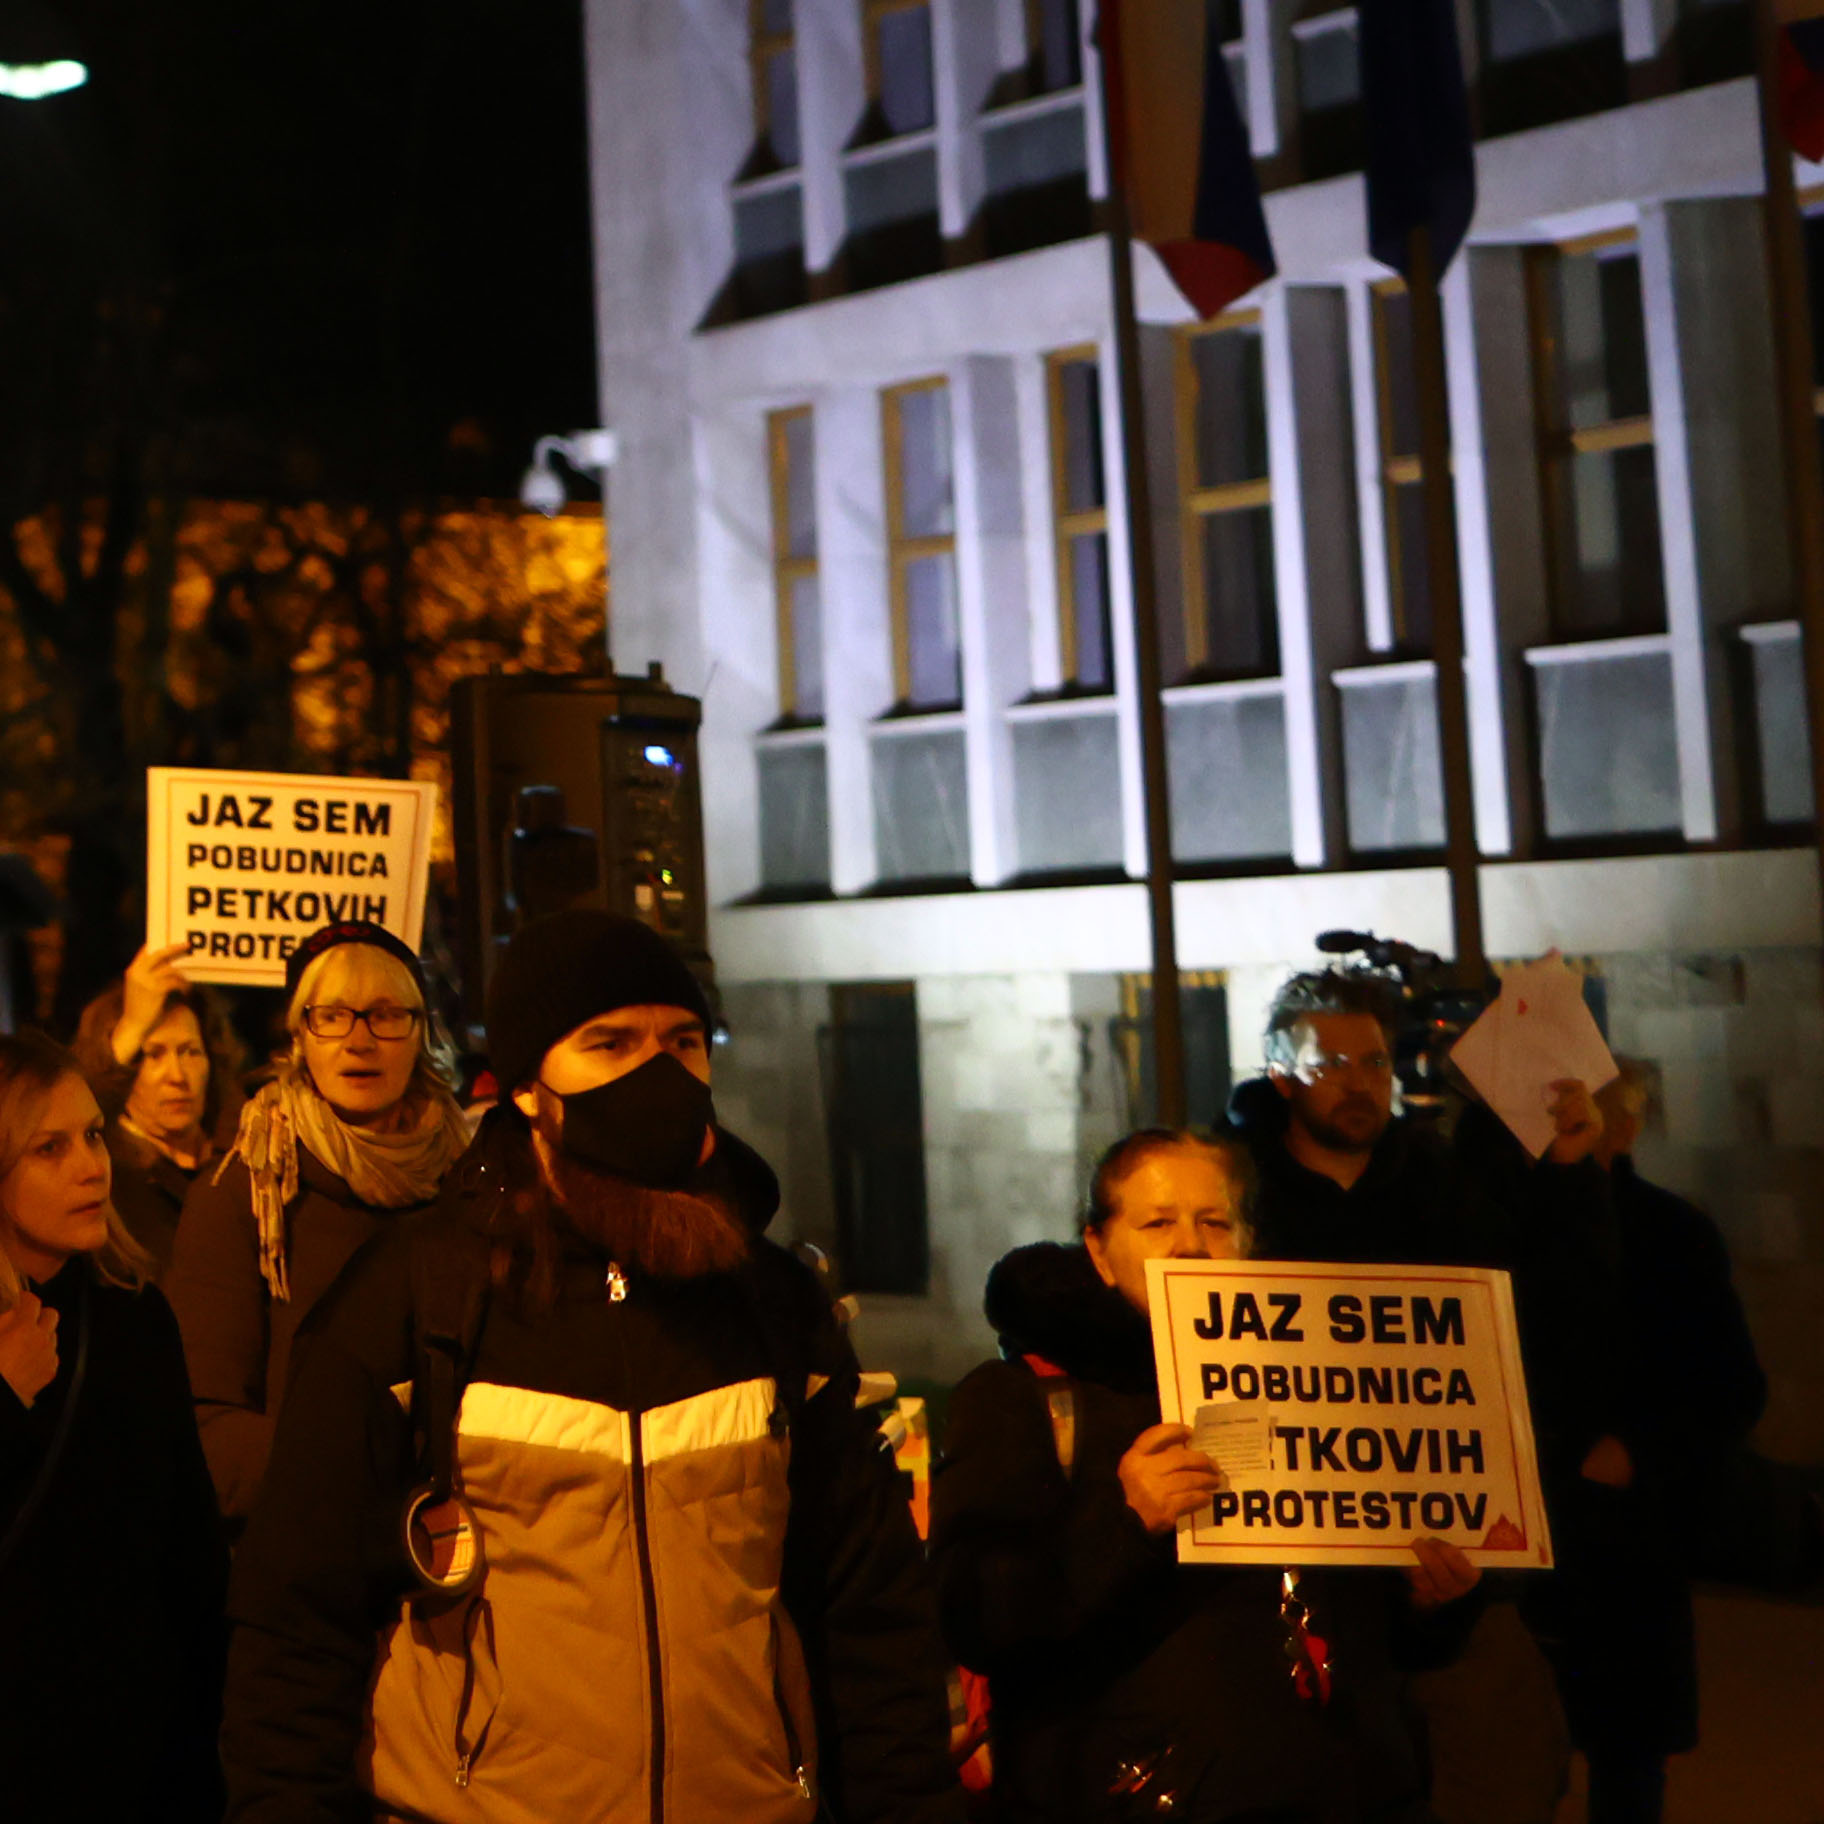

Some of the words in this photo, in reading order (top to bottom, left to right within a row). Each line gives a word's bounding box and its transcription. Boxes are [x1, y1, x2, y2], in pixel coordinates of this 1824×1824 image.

[187, 794, 272, 829] JAZ
[293, 799, 390, 836] SEM
[188, 844, 388, 877] POBUDNICA
[187, 887, 386, 924] PETKOVIH
[1193, 1292, 1304, 1342] JAZ
[1328, 1294, 1466, 1345] SEM
[1200, 1363, 1476, 1405] POBUDNICA
[1212, 1490, 1487, 1530] PROTESTOV
